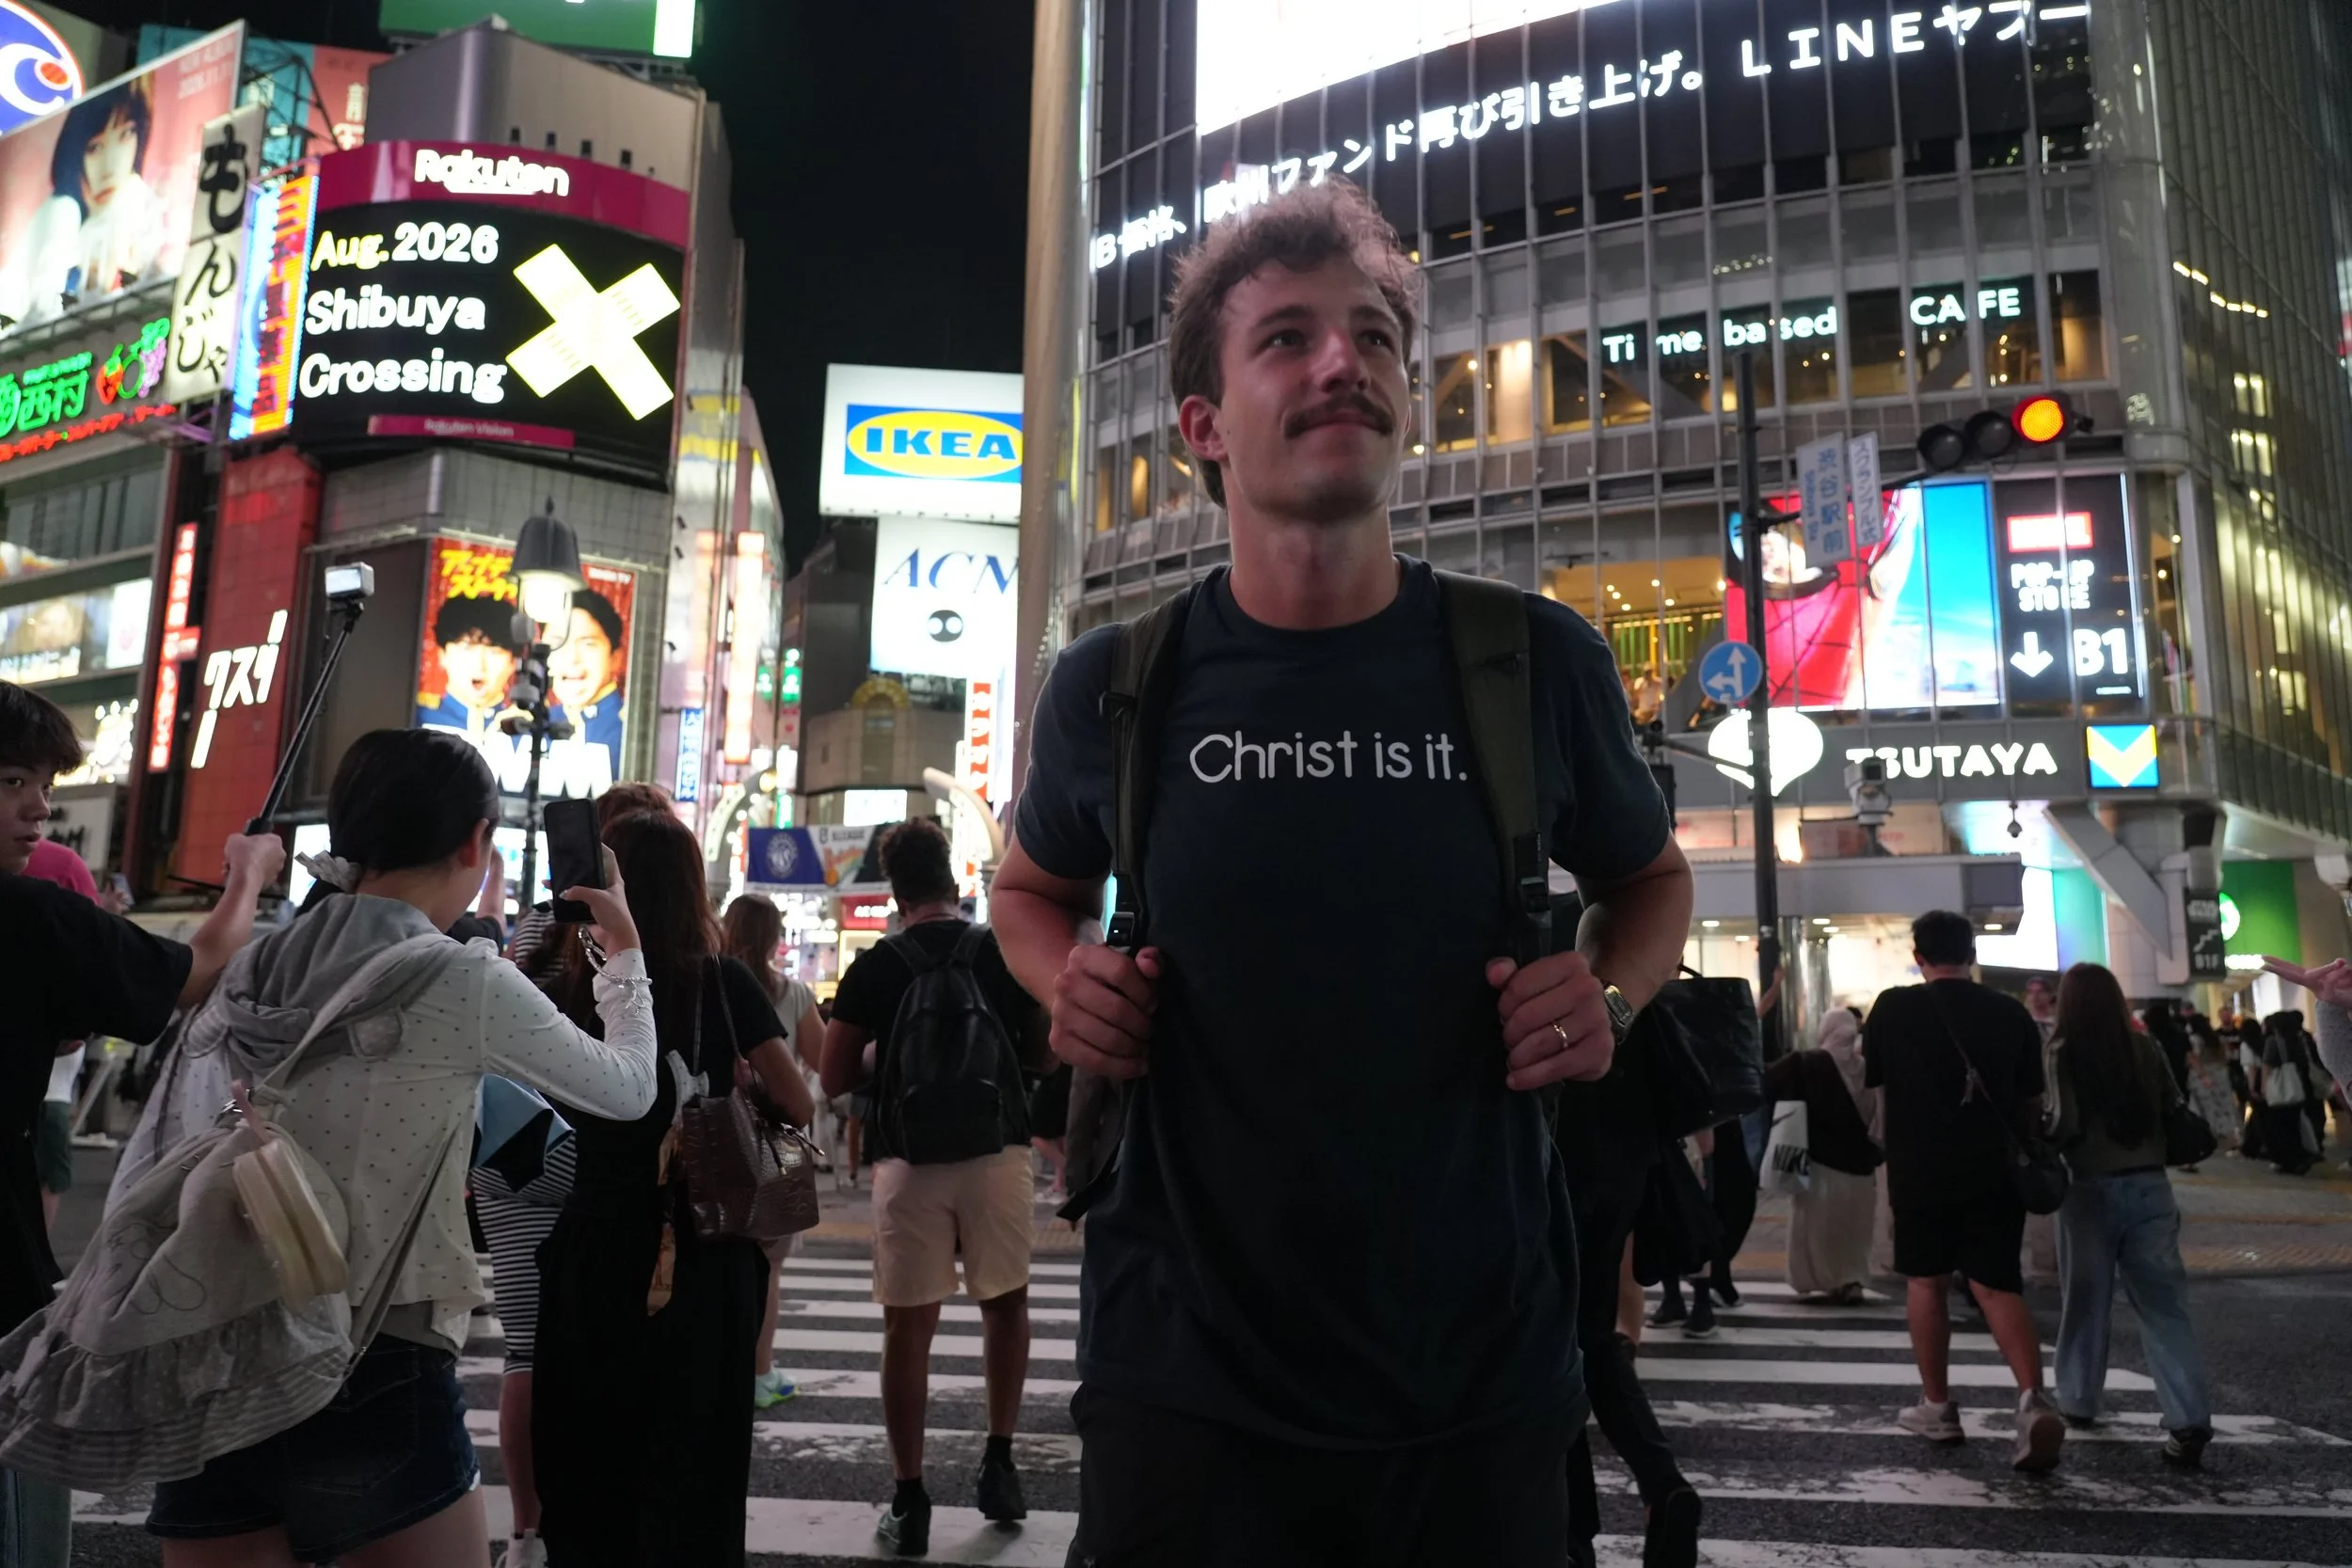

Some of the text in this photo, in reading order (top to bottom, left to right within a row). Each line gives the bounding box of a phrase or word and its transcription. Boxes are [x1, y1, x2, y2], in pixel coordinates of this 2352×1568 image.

[414, 149, 570, 197] Rakuten
[177, 123, 247, 385] もんじゃ
[305, 283, 486, 336] Shibuya
[1723, 306, 1838, 347] based
[1909, 287, 2022, 326] CAFE
[298, 347, 509, 404] Crossing
[864, 427, 1019, 461] IKEA
[1817, 446, 1844, 554] 渋谷駅前
[2073, 628, 2129, 676] B1
[1189, 730, 1468, 784] Christ is it.
[1845, 742, 2058, 780] TSUTAYA
